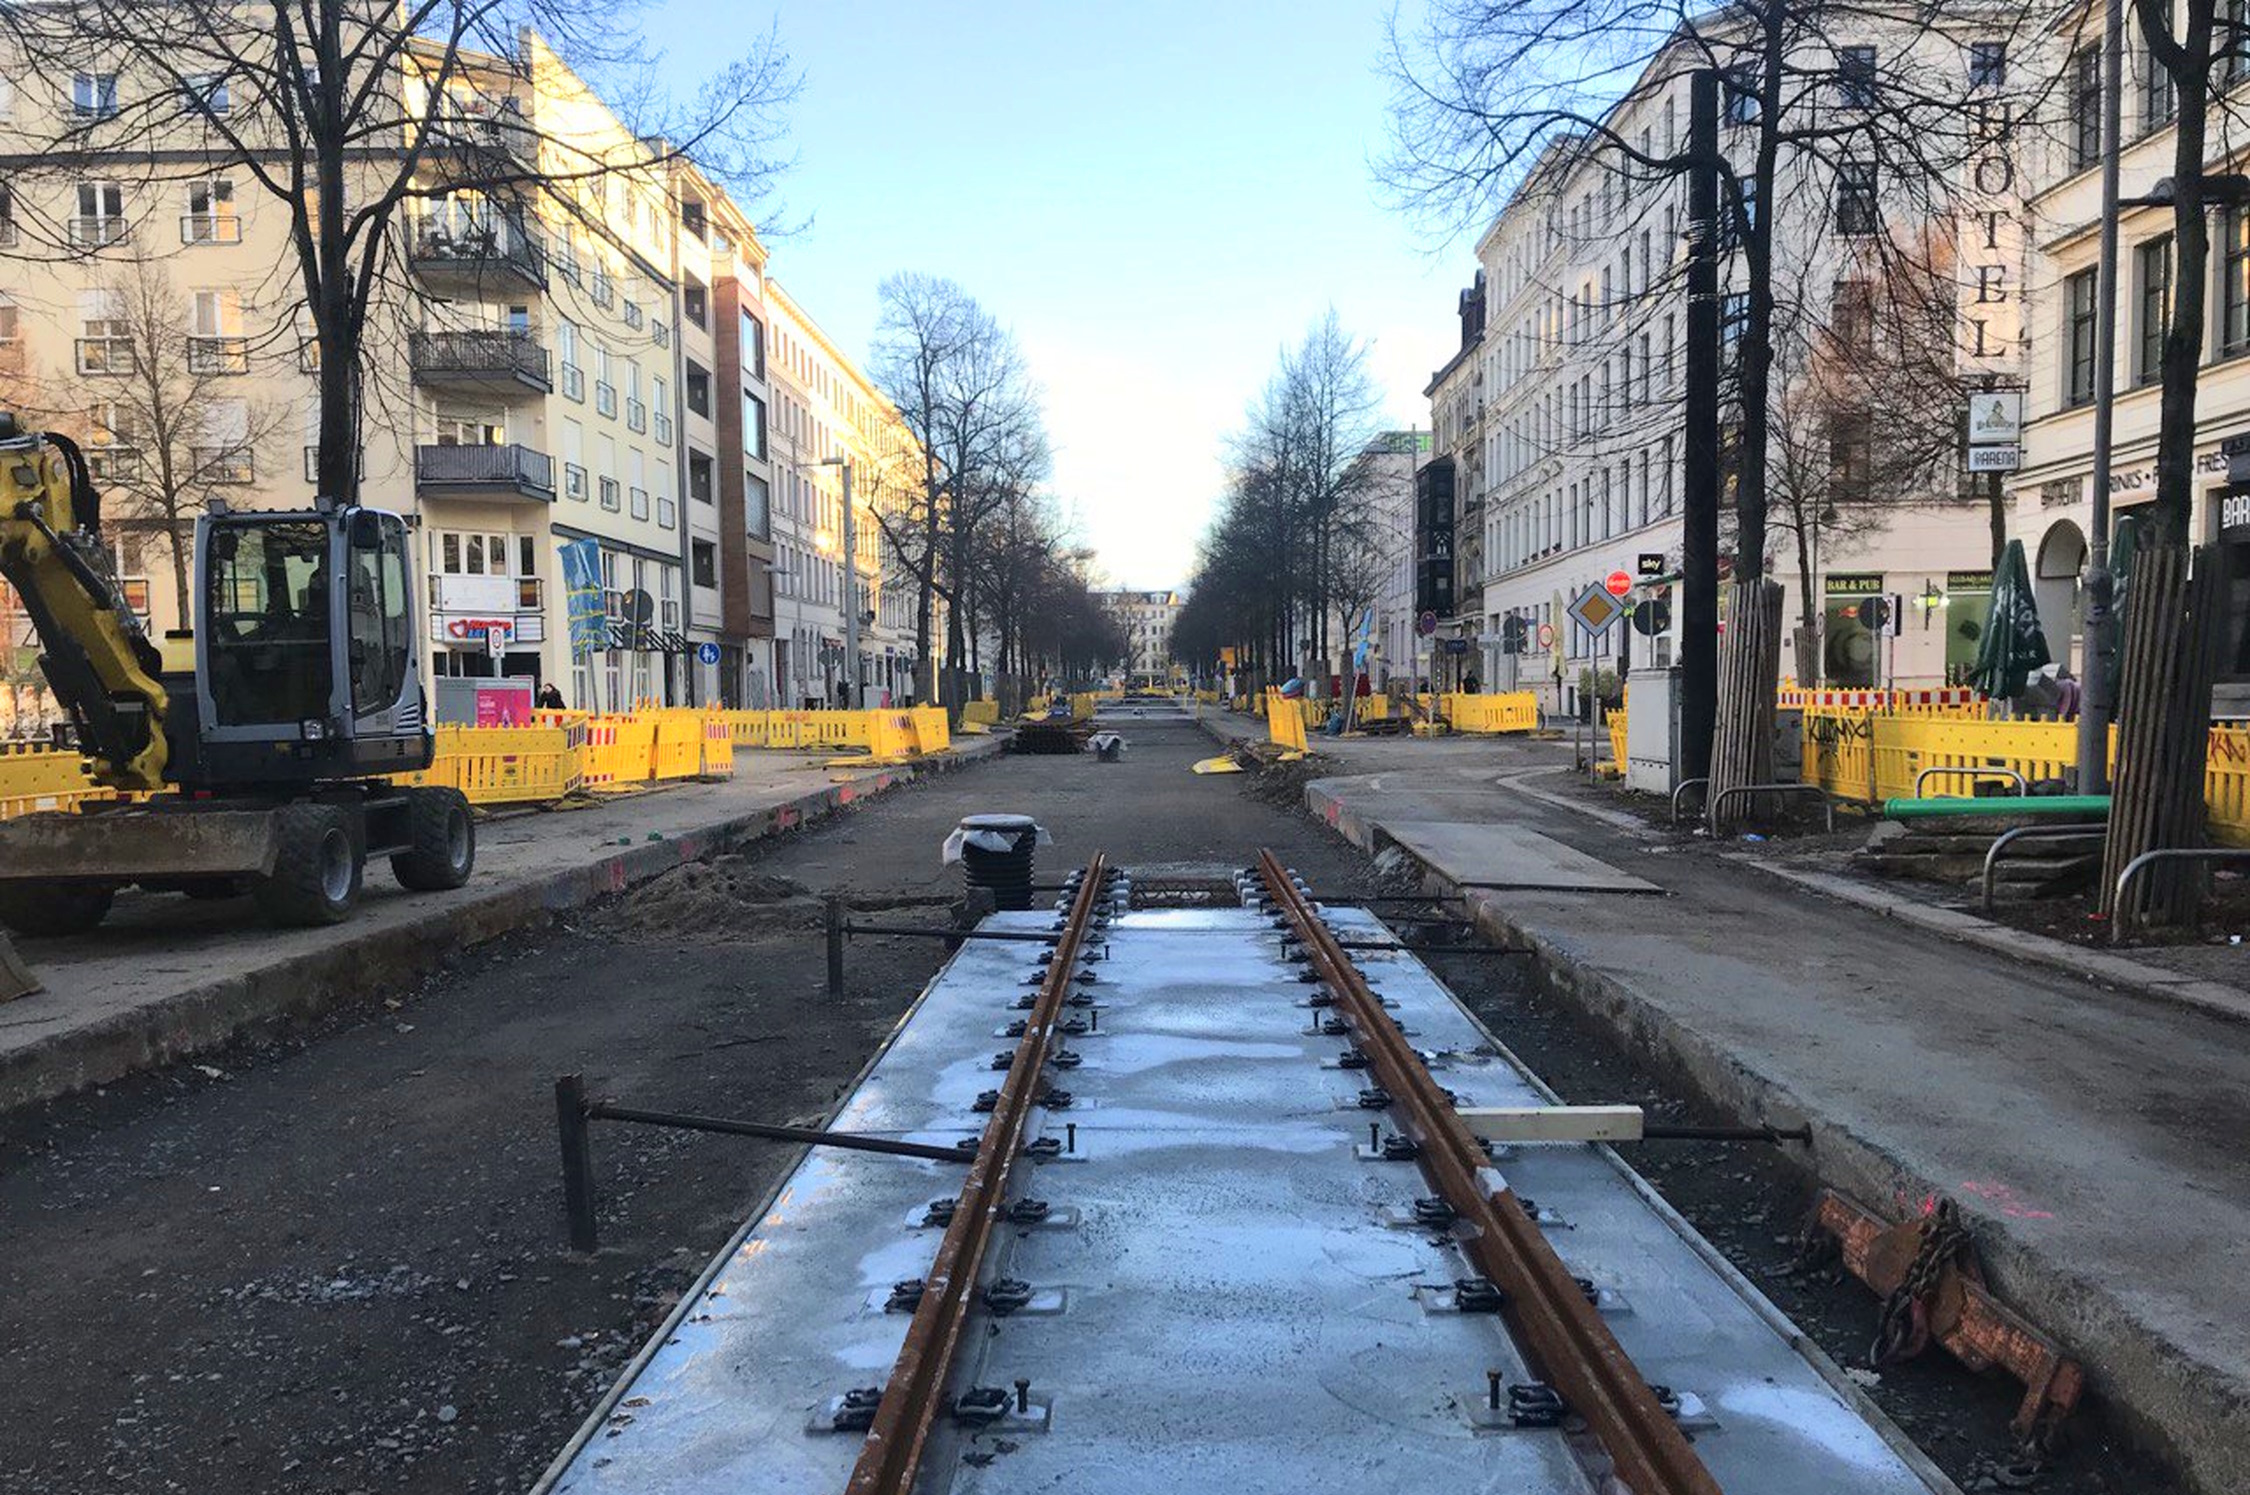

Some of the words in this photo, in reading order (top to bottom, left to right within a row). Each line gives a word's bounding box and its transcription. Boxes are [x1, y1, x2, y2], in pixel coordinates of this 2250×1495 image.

[1973, 102, 2016, 357] HOTEL
[1642, 559, 1661, 570] sky
[1827, 580, 1848, 591] BAR
[1850, 580, 1858, 590] &
[1859, 579, 1881, 590] PUB
